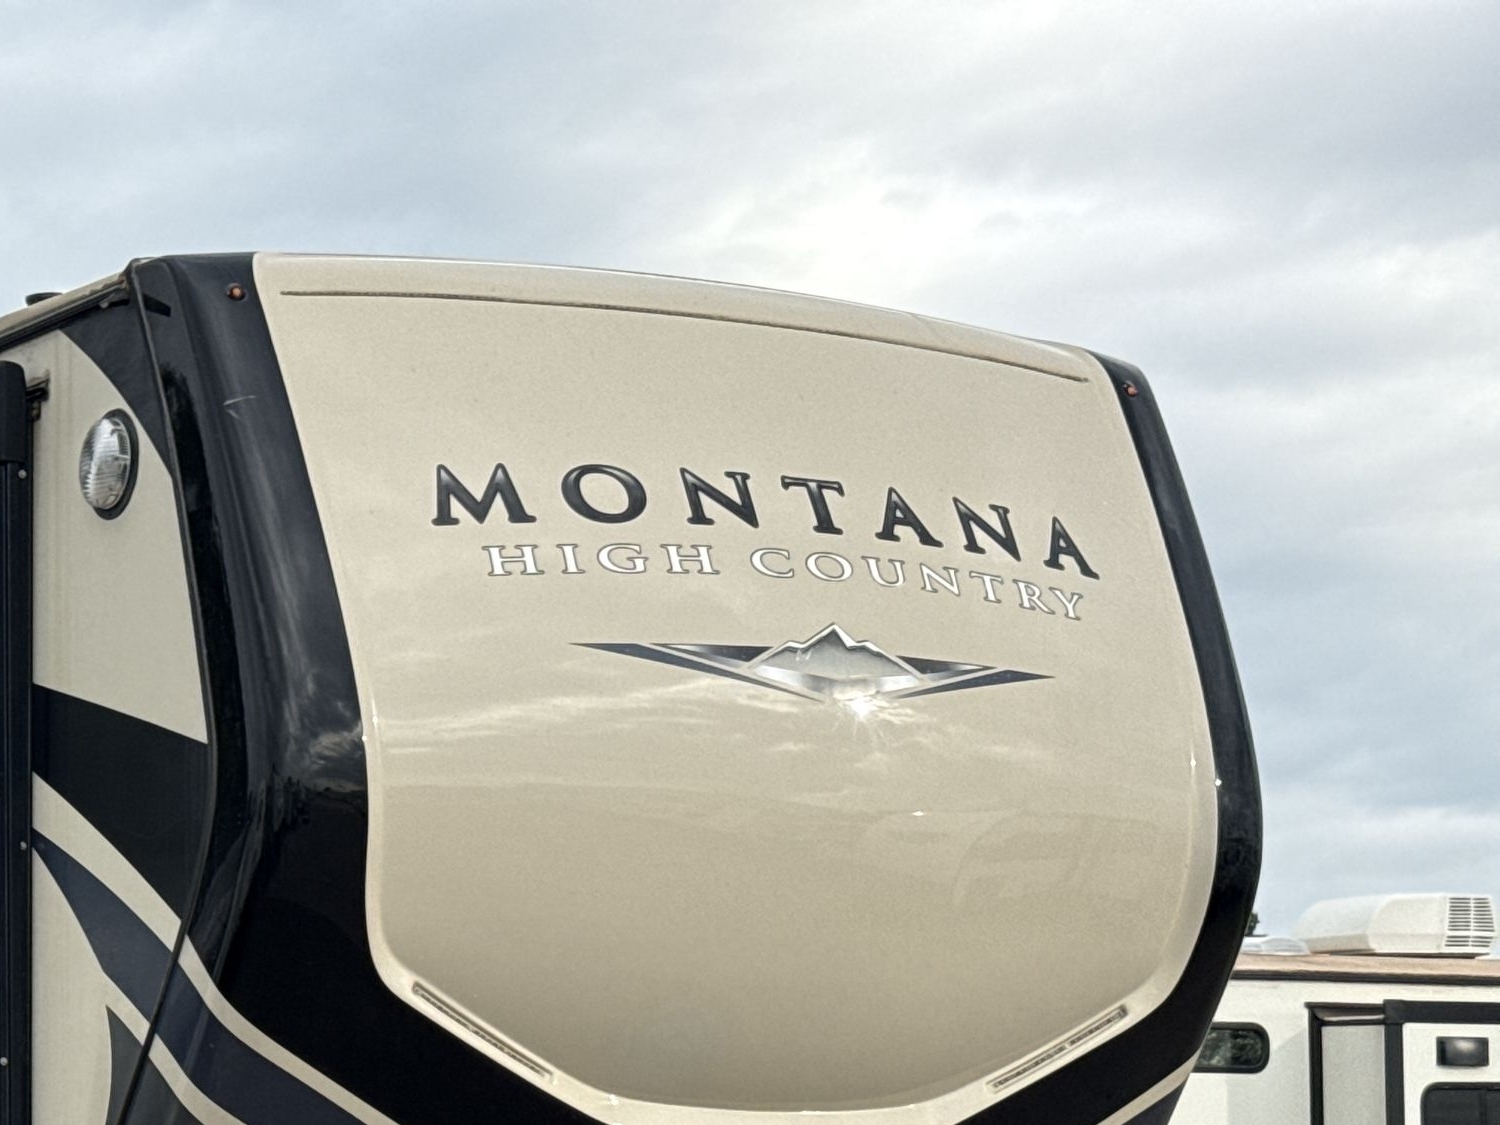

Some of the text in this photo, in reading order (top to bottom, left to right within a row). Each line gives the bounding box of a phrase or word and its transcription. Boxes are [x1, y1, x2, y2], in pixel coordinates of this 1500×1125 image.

[432, 463, 1099, 580] MONTANA
[482, 542, 1082, 621] HIGH COUNTRY
